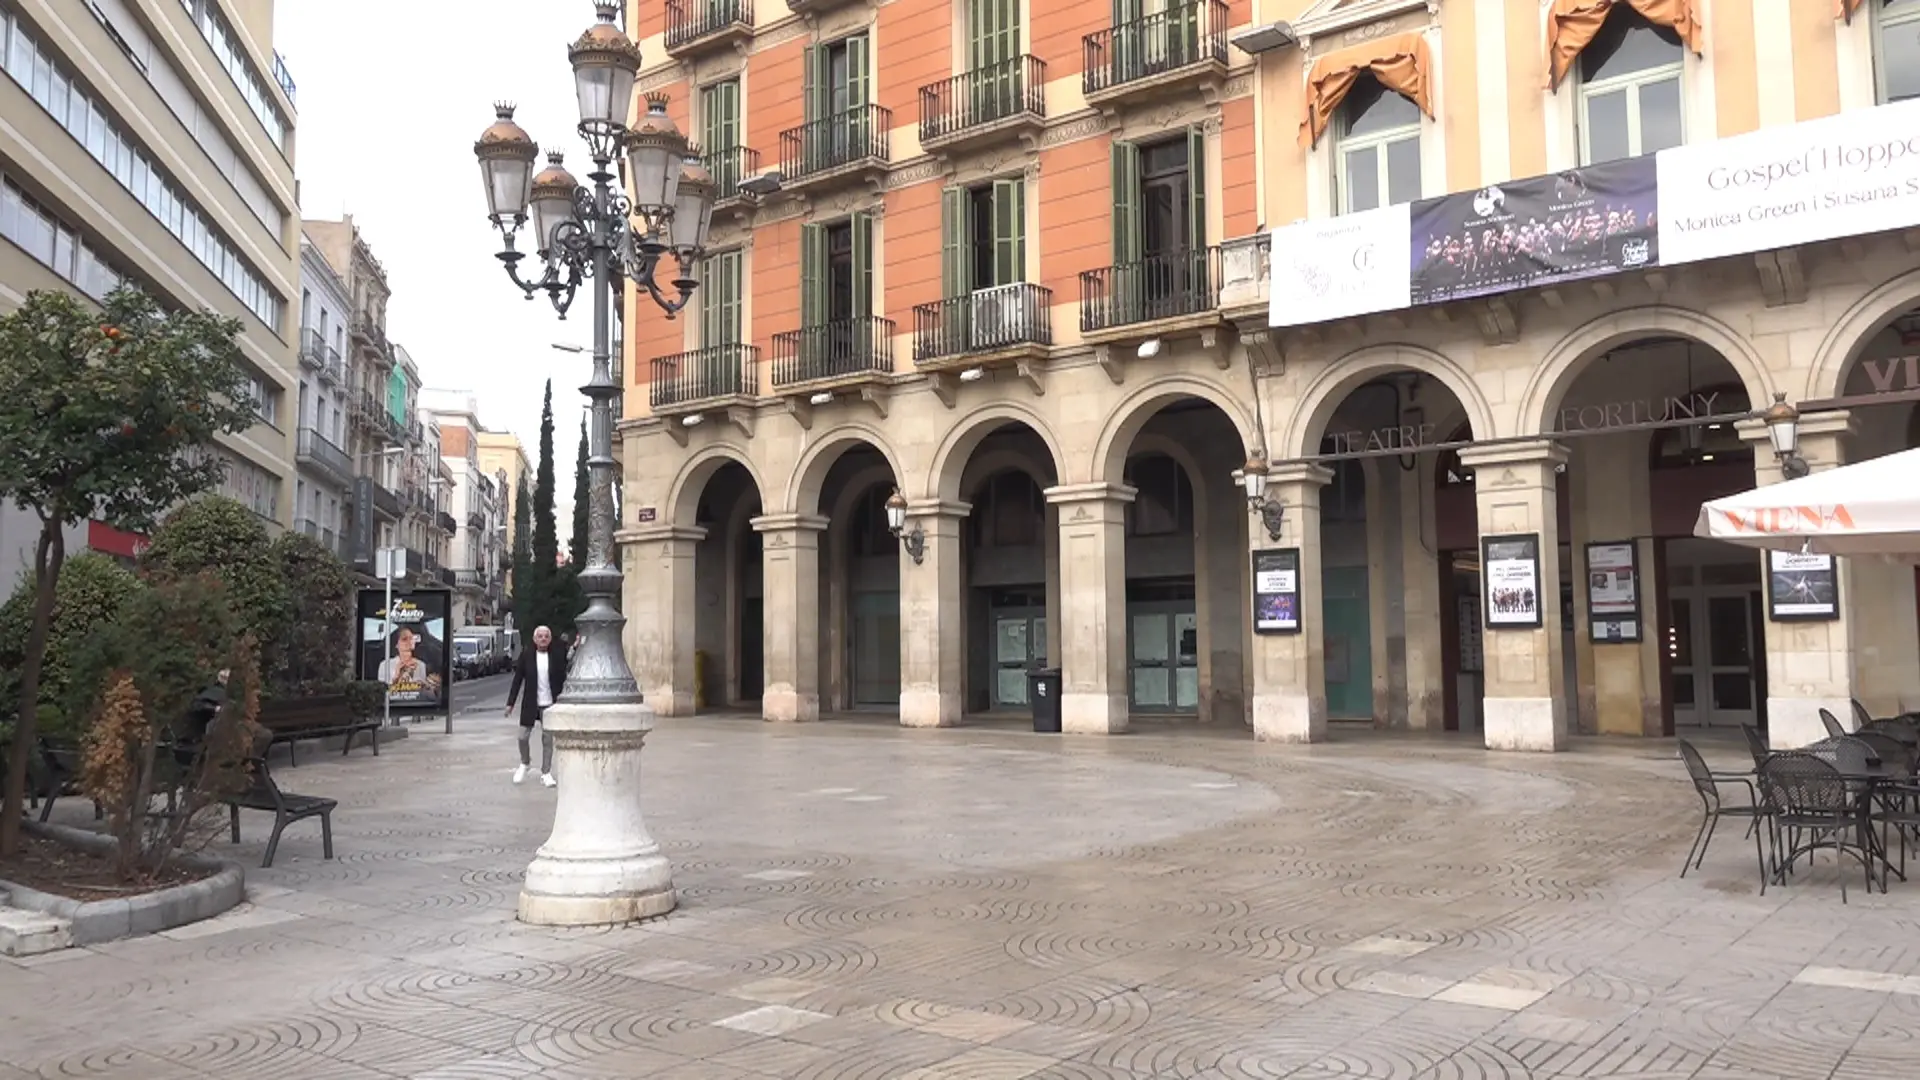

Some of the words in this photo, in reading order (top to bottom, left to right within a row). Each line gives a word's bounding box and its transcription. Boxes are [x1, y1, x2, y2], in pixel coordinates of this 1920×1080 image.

[1674, 211, 1742, 233] Monica
[1748, 199, 1806, 221] Green
[1824, 183, 1898, 209] Susana
[1862, 355, 1920, 391] VI
[1328, 424, 1437, 456] TEATRE
[1561, 391, 1719, 432] FORTUNY
[1723, 503, 1856, 533] VIENA
